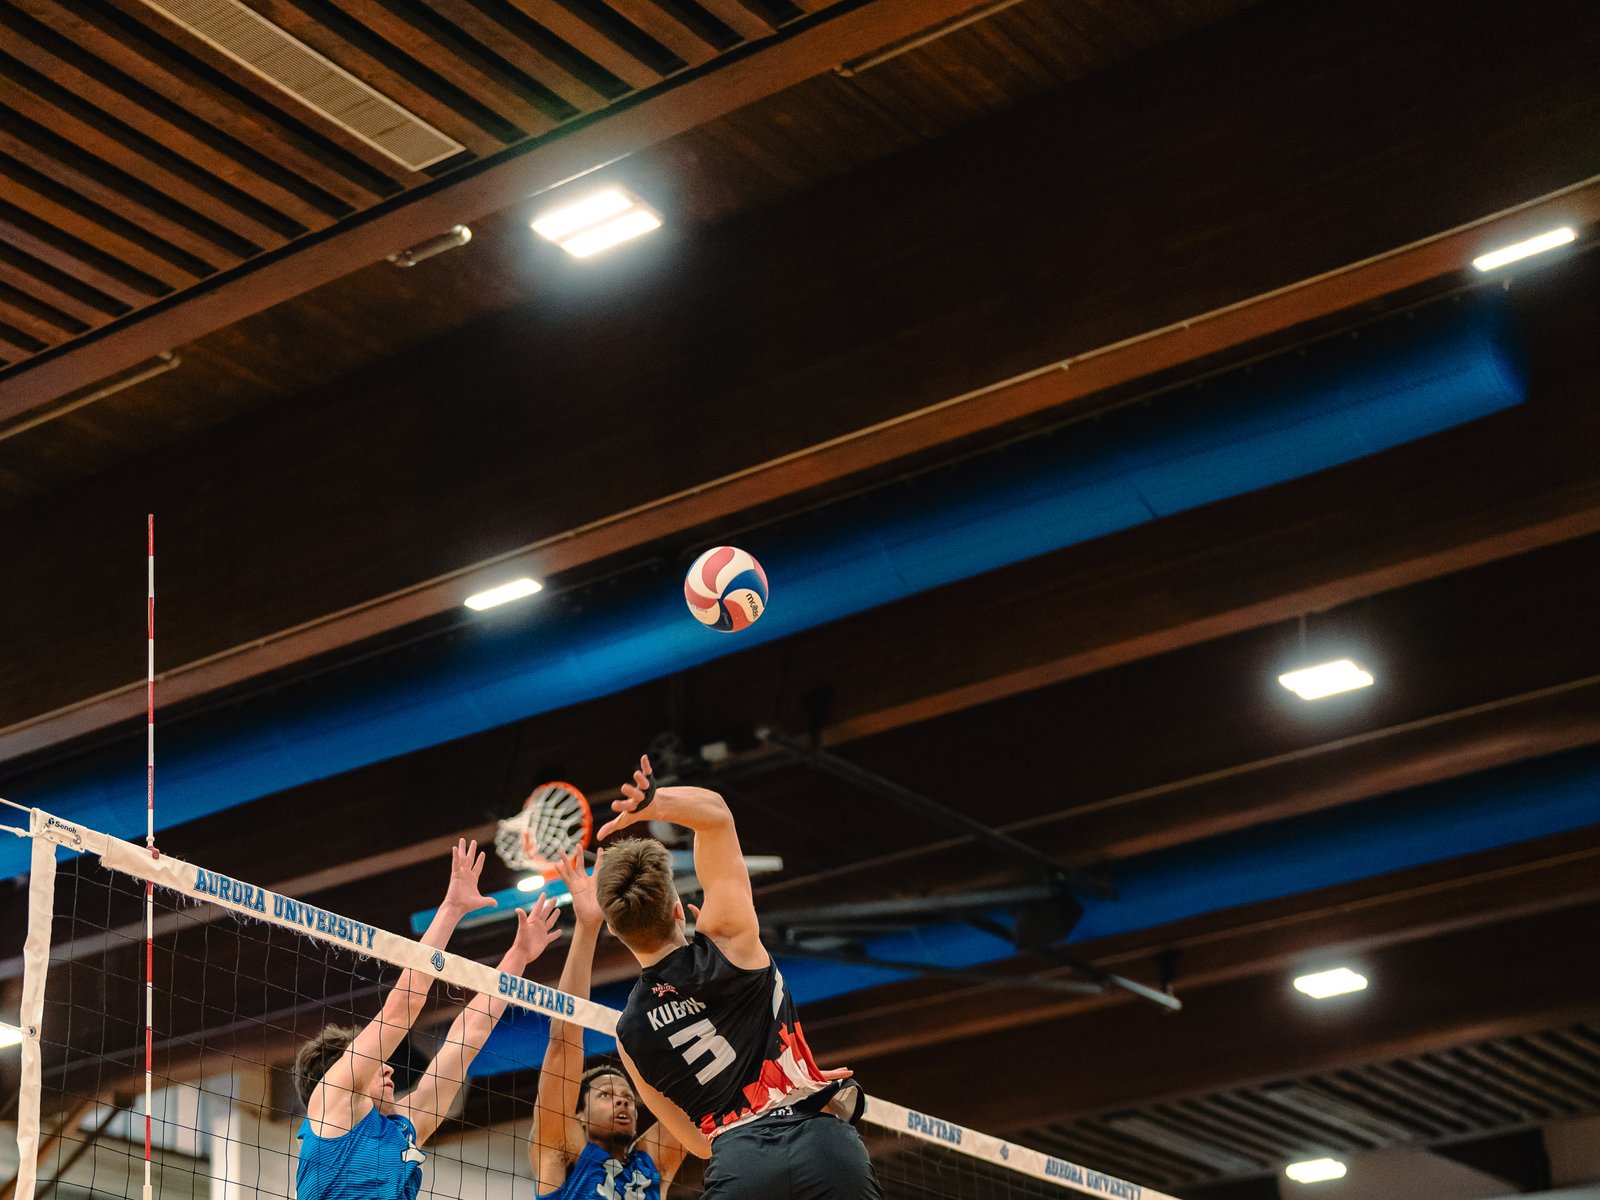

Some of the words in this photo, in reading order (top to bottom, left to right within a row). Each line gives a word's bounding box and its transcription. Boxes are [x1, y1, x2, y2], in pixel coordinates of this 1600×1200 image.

[54, 820, 77, 834] Senoh
[193, 867, 266, 914] AURORA
[272, 892, 377, 950] UNIVERSITY
[498, 971, 576, 1017] SPARTANS
[668, 1018, 737, 1086] 3
[908, 1110, 962, 1146] SPARTANS
[1045, 1158, 1083, 1185] AURORA
